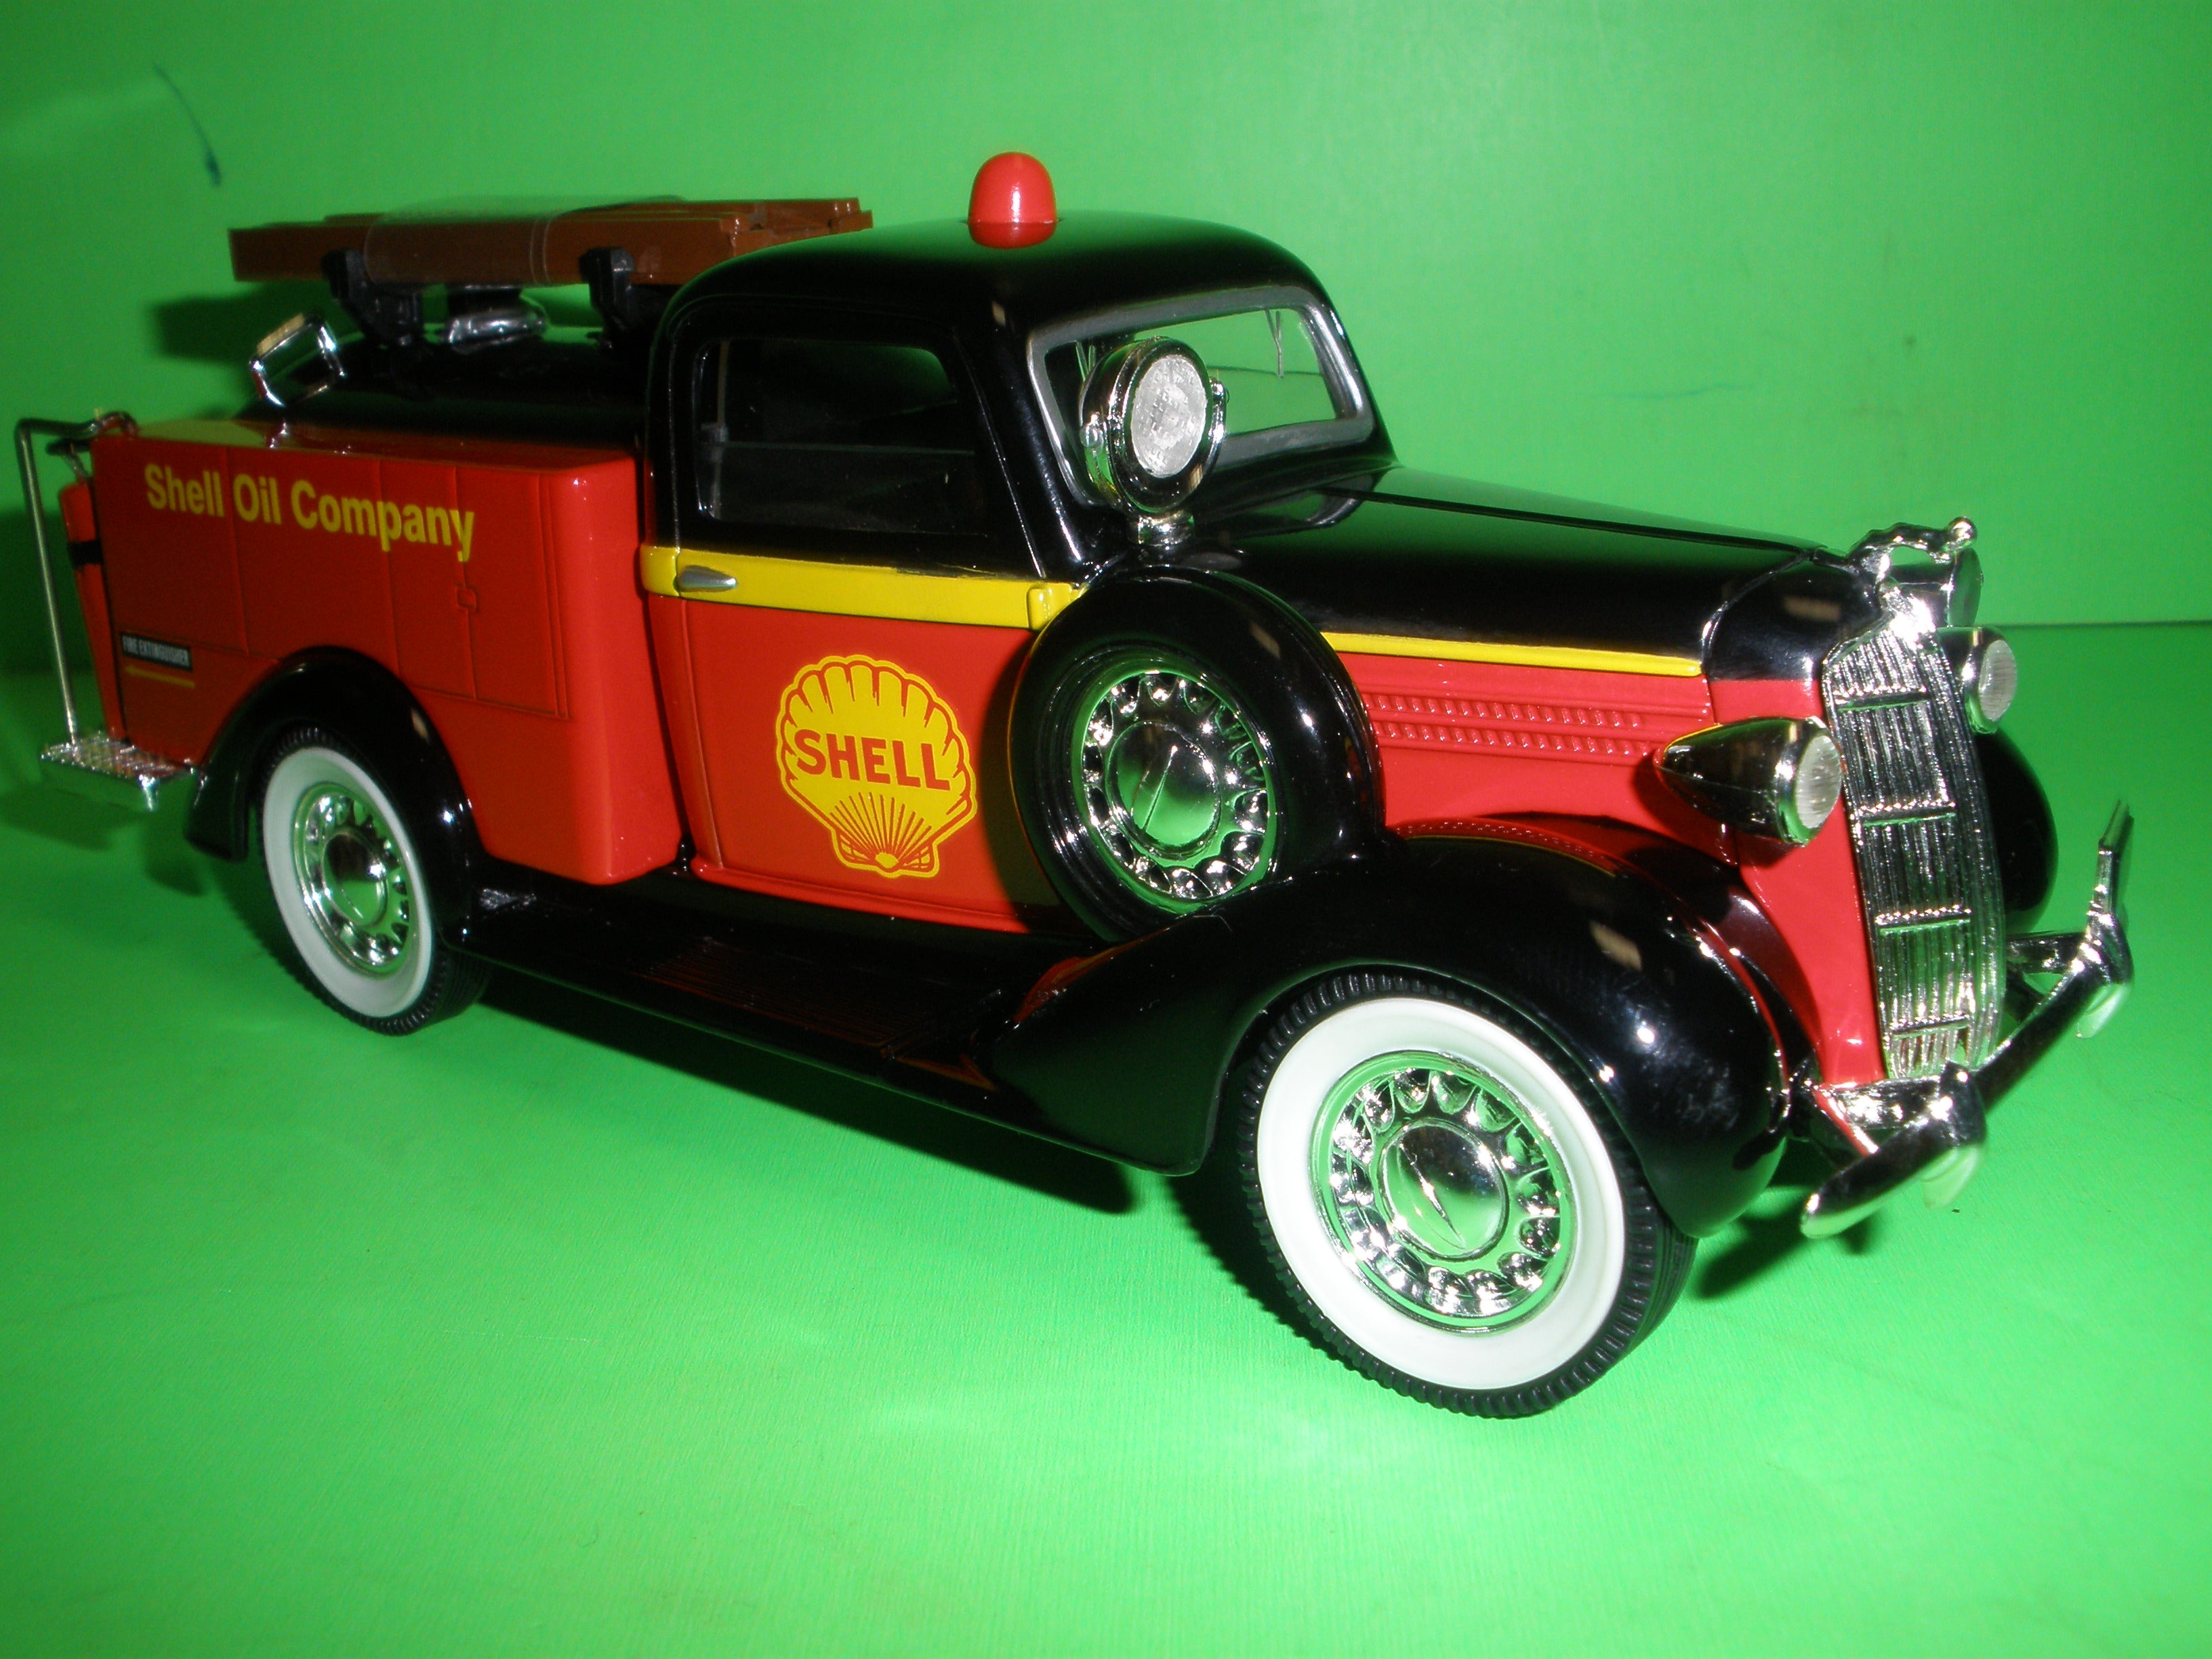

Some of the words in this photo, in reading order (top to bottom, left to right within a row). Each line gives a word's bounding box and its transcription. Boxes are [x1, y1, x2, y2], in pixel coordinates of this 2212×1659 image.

[144, 464, 224, 517] Shell
[233, 474, 282, 525] Oil
[291, 480, 475, 563] Company
[794, 729, 951, 792] SHELL
